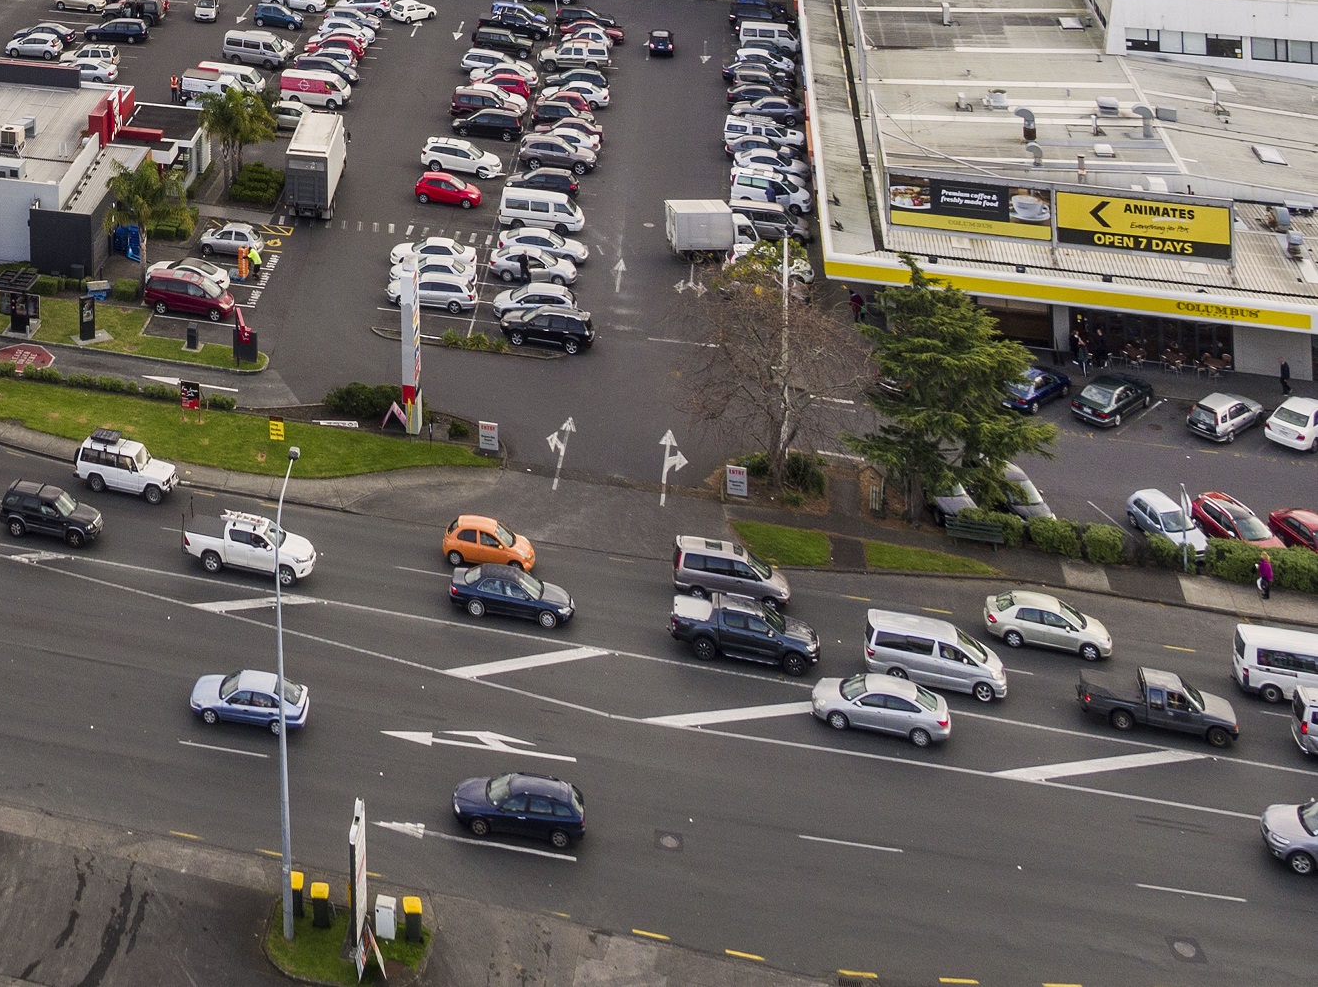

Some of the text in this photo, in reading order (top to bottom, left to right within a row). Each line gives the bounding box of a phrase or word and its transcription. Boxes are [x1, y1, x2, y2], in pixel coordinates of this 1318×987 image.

[940, 196, 999, 207] freshly made food
[941, 189, 970, 197] Premium
[970, 192, 991, 201] coffee
[1123, 203, 1195, 220] ANIMATES
[948, 219, 993, 229] COLUMBUS
[1130, 221, 1166, 234] Everything
[1093, 233, 1193, 254] OPEN 7 DAYS
[1175, 301, 1260, 319] COLUMBUS
